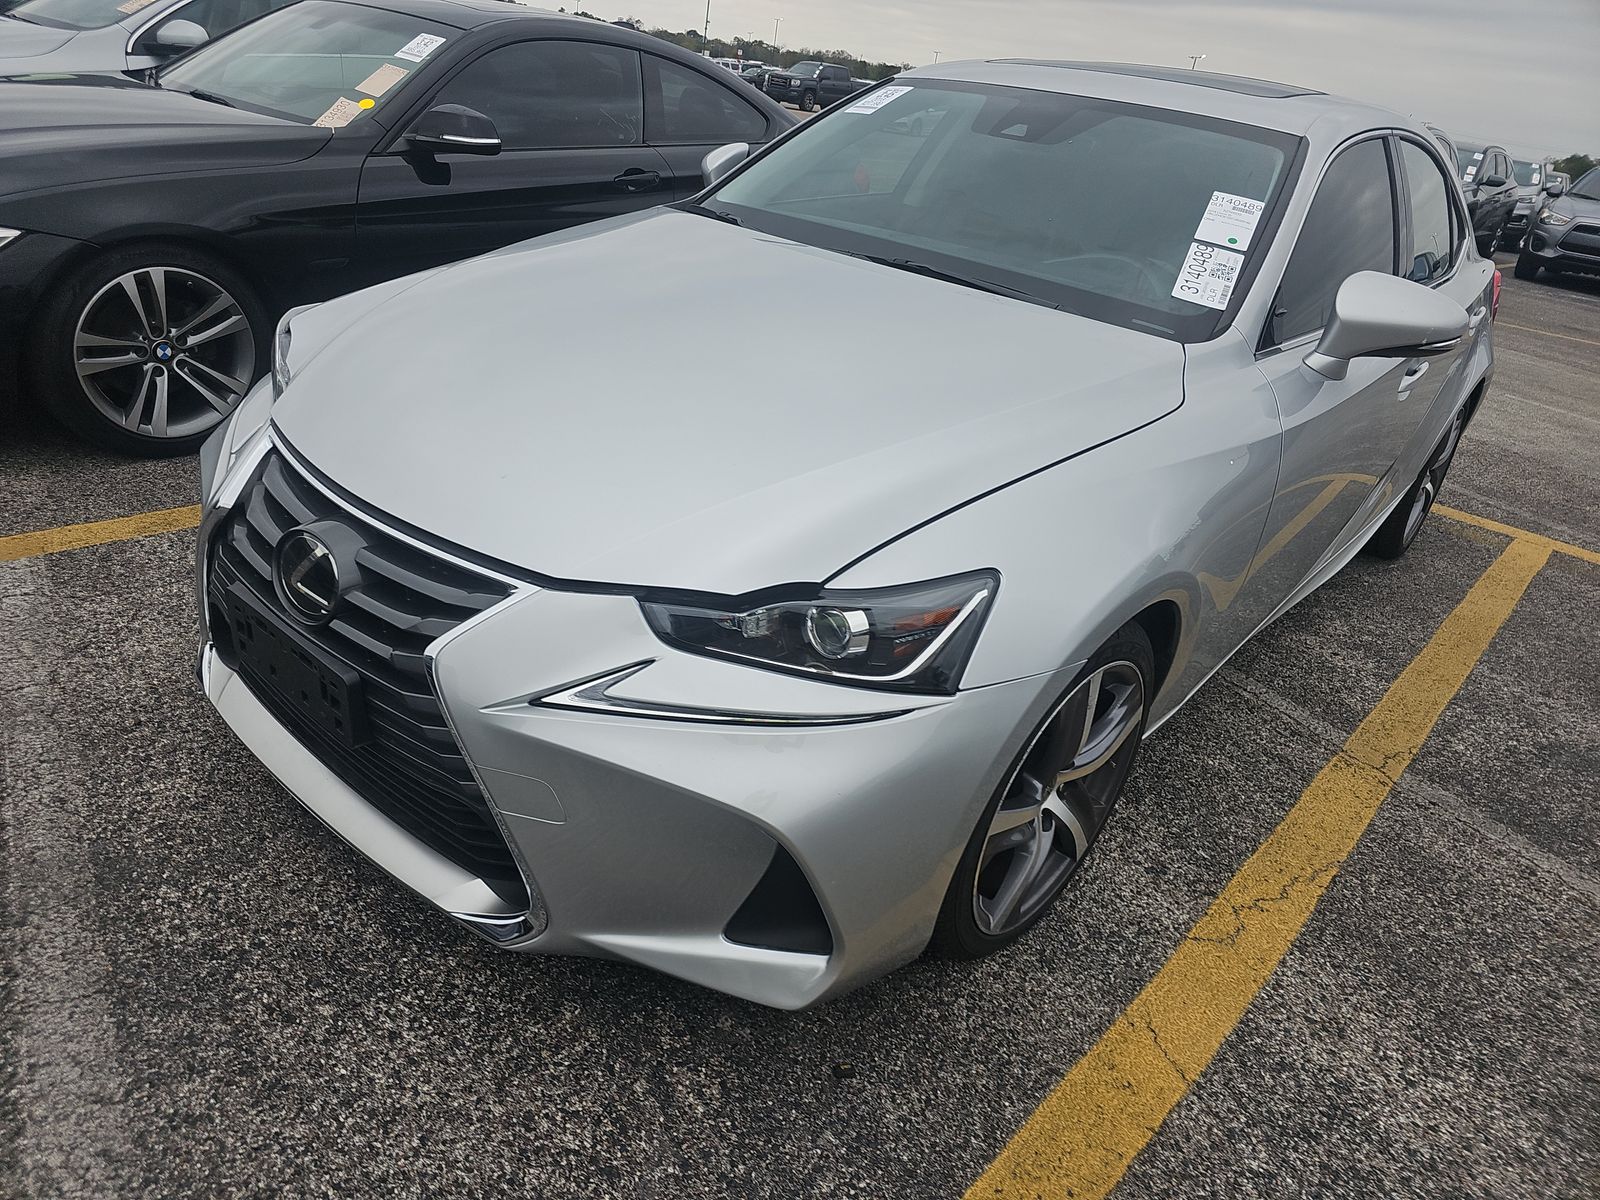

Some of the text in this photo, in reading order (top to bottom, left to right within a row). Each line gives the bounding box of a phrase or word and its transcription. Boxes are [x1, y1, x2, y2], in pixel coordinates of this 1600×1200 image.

[1211, 195, 1263, 212] 3140489
[1180, 244, 1215, 295] 3140489
[1206, 288, 1219, 303] DLR
